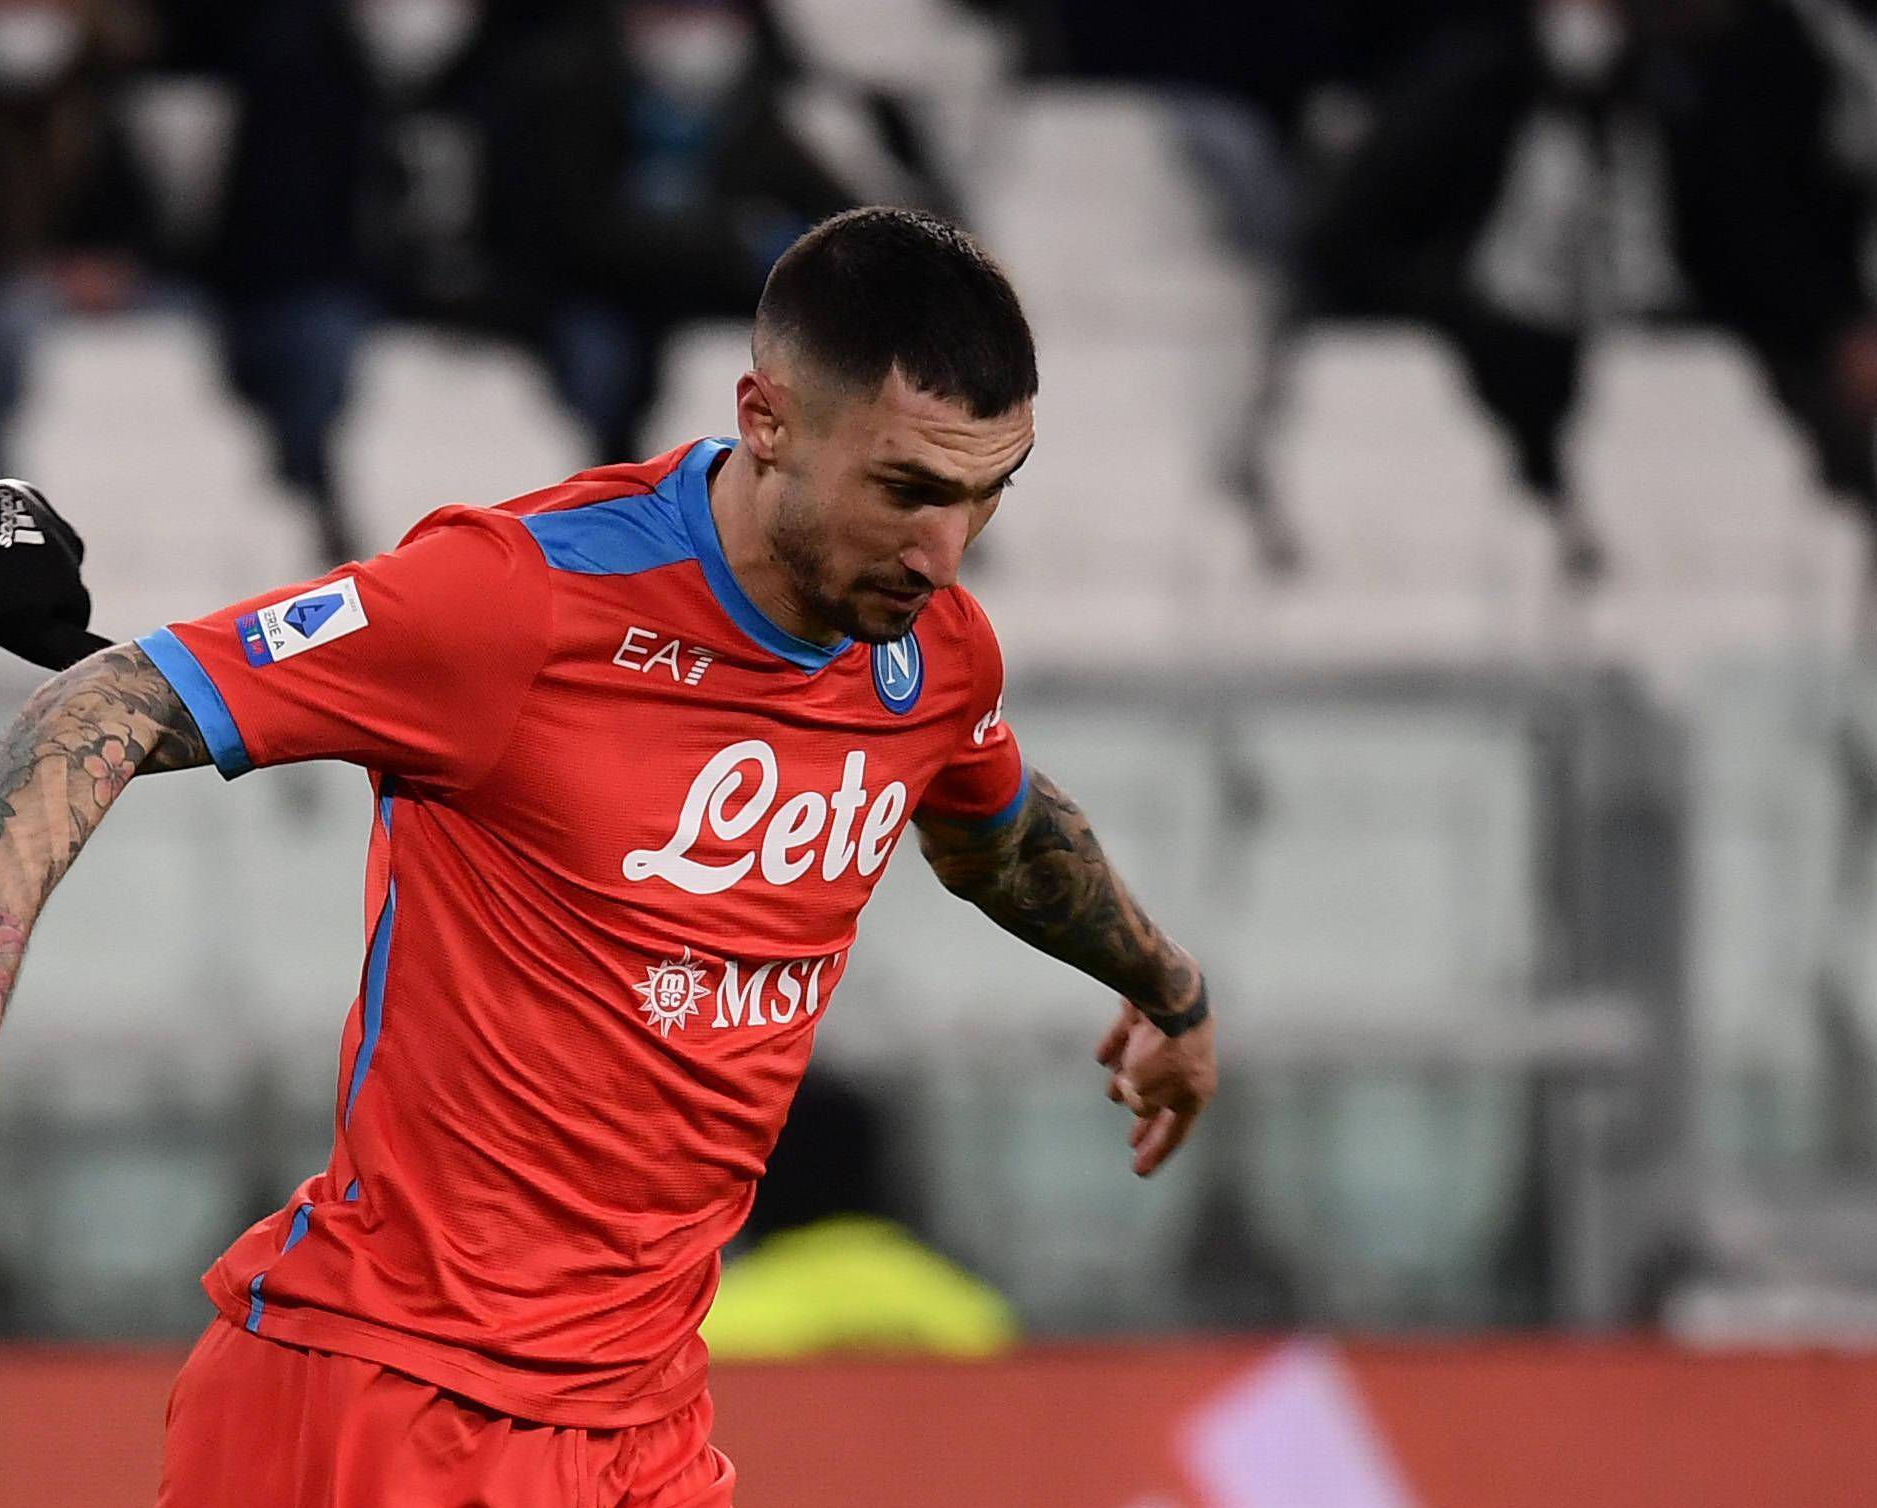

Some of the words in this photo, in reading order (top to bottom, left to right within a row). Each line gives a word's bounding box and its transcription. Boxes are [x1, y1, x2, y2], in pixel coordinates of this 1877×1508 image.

[612, 626, 714, 686] EA7
[885, 638, 911, 685] N
[623, 739, 907, 895] Lete
